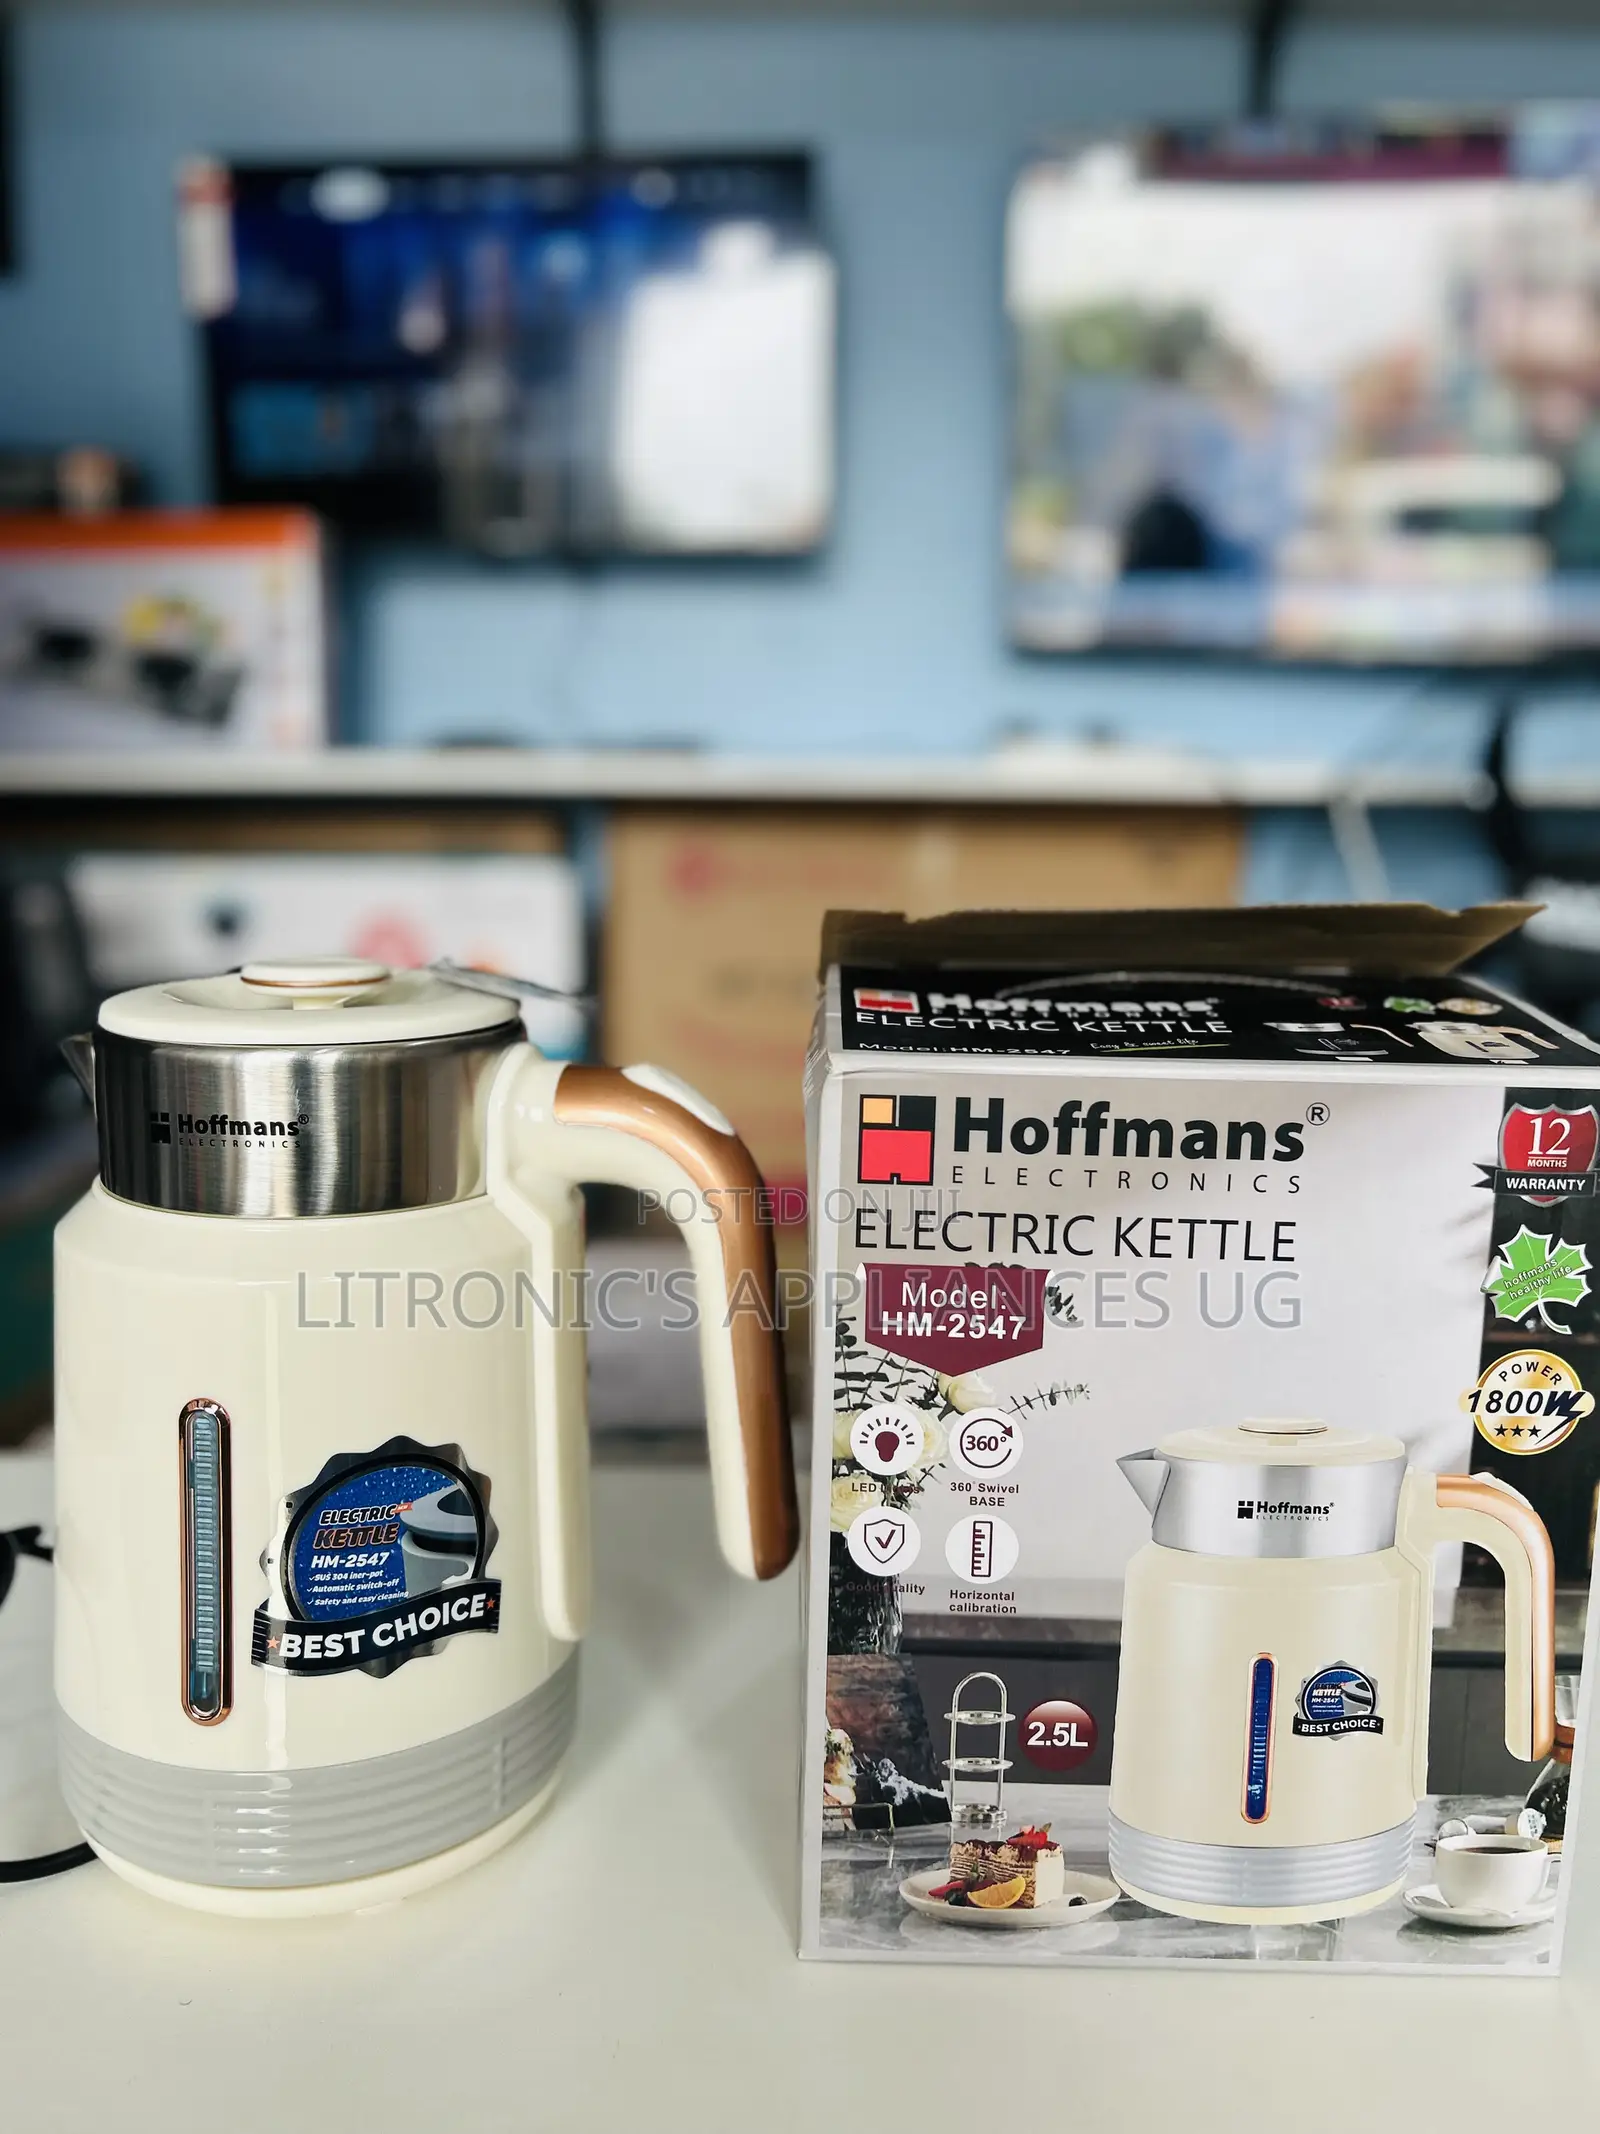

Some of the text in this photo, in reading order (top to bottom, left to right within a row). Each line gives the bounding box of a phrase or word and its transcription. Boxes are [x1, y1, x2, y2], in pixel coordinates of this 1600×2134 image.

[856, 1012, 1232, 1034] ELECTRIC KETTLE
[178, 1138, 301, 1149] ELECTRONICS
[1527, 1117, 1571, 1156] 12
[1526, 1158, 1568, 1169] MONTHS
[952, 1165, 1301, 1195] ELECTRONICS
[1505, 1177, 1587, 1193] WARRANTY
[854, 1207, 1297, 1263] ELECTRIC KETTLE
[1503, 1258, 1558, 1289] hoffmans
[1508, 1264, 1573, 1301] healthy life
[901, 1281, 1007, 1310] Model:
[881, 1311, 1027, 1340] HM-2547
[1498, 1361, 1563, 1384] POWER
[1466, 1388, 1587, 1419] 1800W
[851, 1482, 877, 1493] LED
[978, 1482, 1019, 1494] Swivel
[969, 1496, 1005, 1507] BASE
[319, 1503, 398, 1527] ELECTRIC
[313, 1522, 401, 1550] KETTLE
[311, 1551, 391, 1569] HM-2547
[312, 1578, 400, 1594] Automatic switch-off
[314, 1569, 384, 1582] SUS 304 iner-pot
[315, 1590, 410, 1606] Safety and easy cleaning
[949, 1589, 1015, 1601] Horizontal
[949, 1603, 1017, 1614] calibration
[278, 1593, 488, 1660] BEST CHOICE
[1026, 1721, 1089, 1747] 2.5L
[1301, 1719, 1378, 1733] BEST CHOICE
